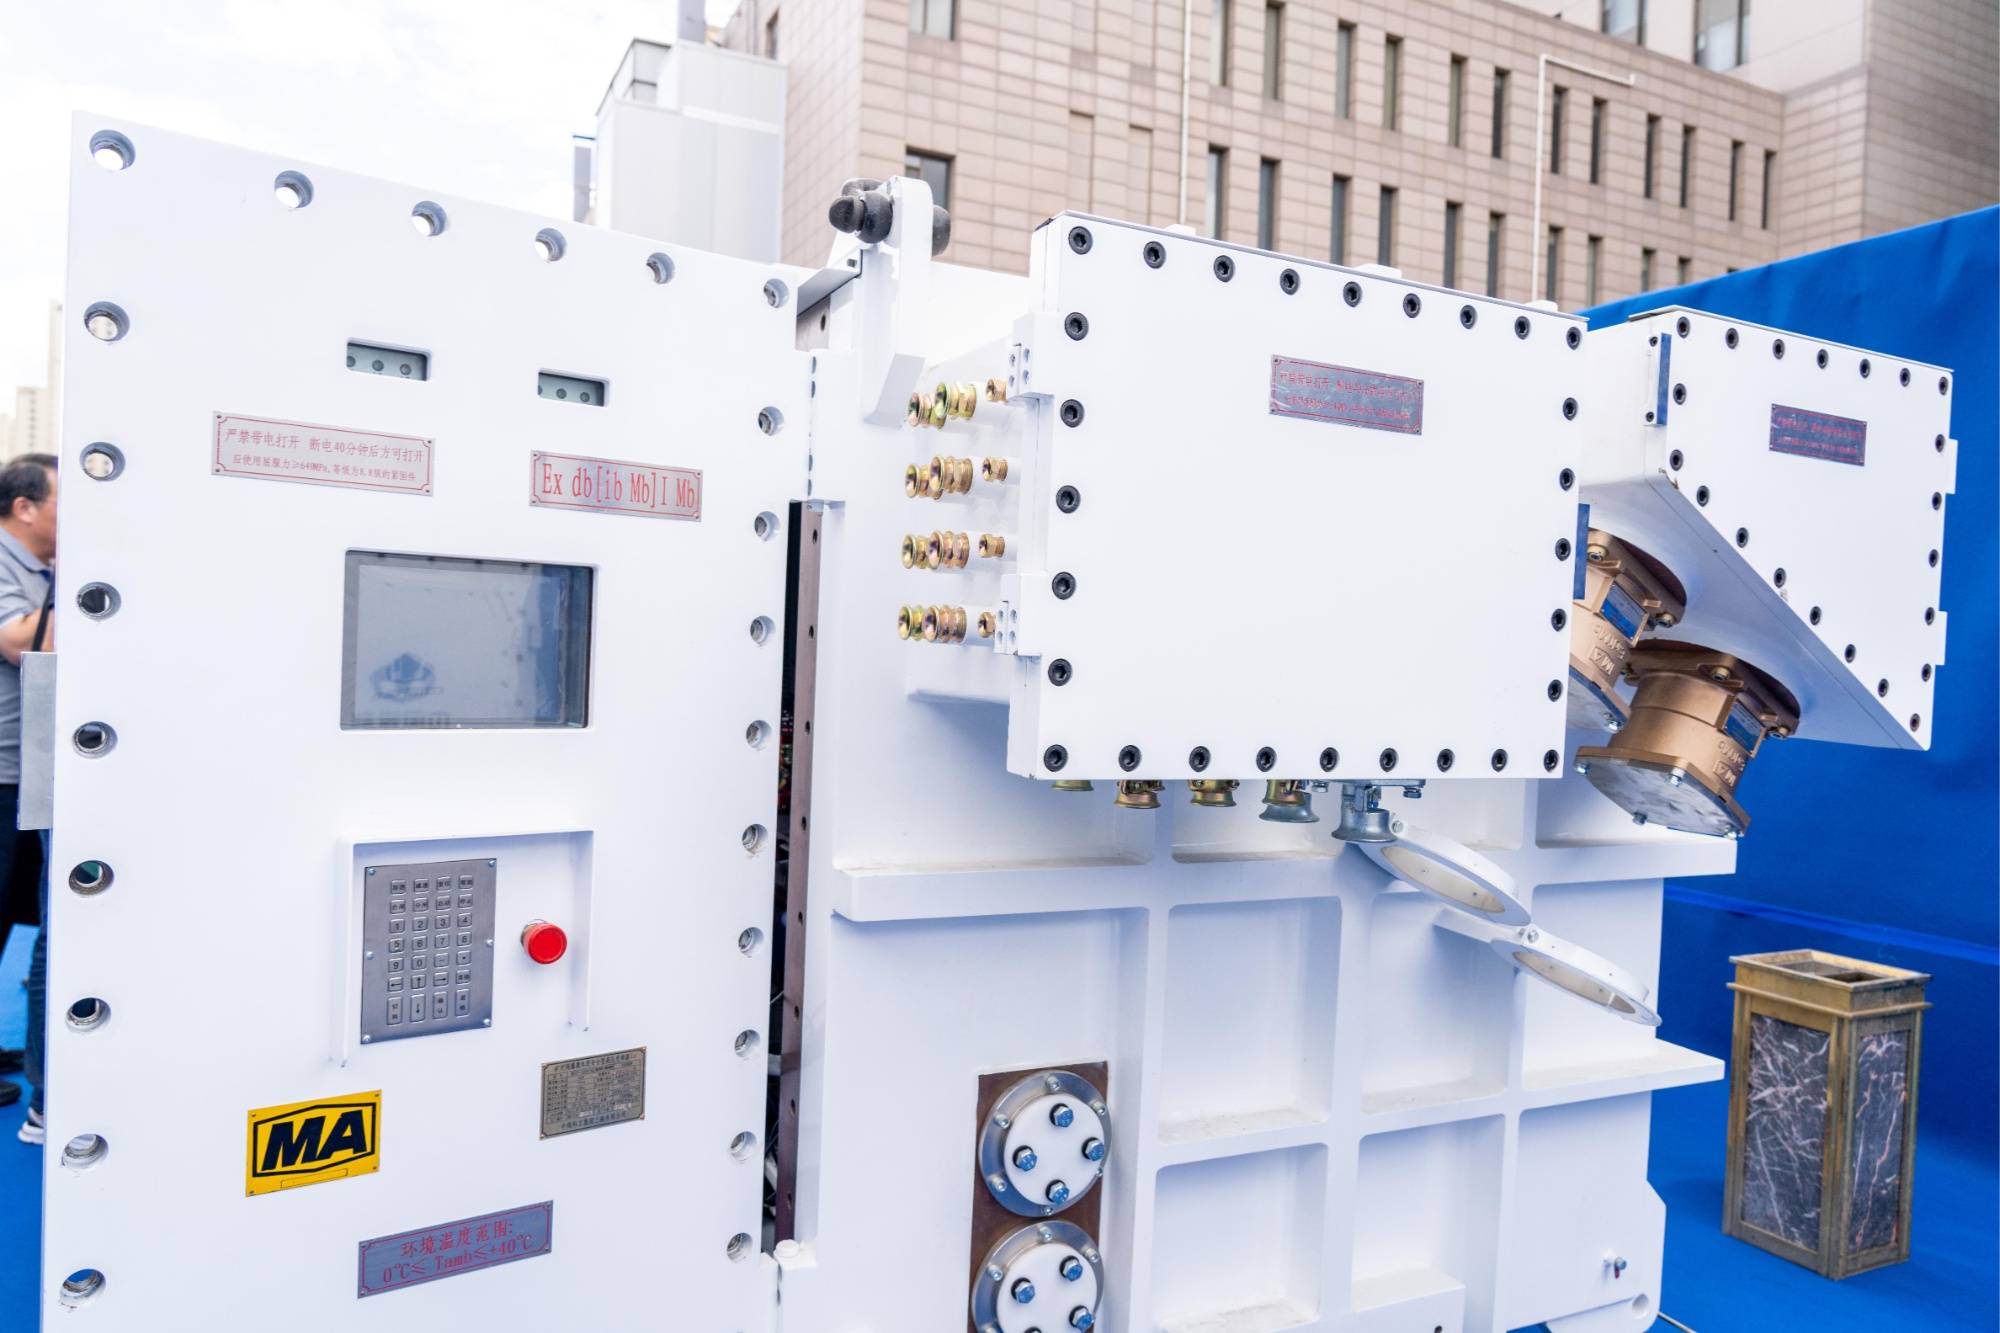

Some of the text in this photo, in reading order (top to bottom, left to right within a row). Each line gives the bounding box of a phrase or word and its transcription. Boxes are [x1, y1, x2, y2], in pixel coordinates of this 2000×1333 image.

[224, 427, 425, 463] 严禁带电打开 断电40分钟后方可打开
[542, 463, 563, 495] Ex
[572, 466, 623, 502] db[ib
[676, 478, 695, 508] Mb
[261, 1109, 367, 1171] MA
[401, 1219, 513, 1258] 环境温度范围:
